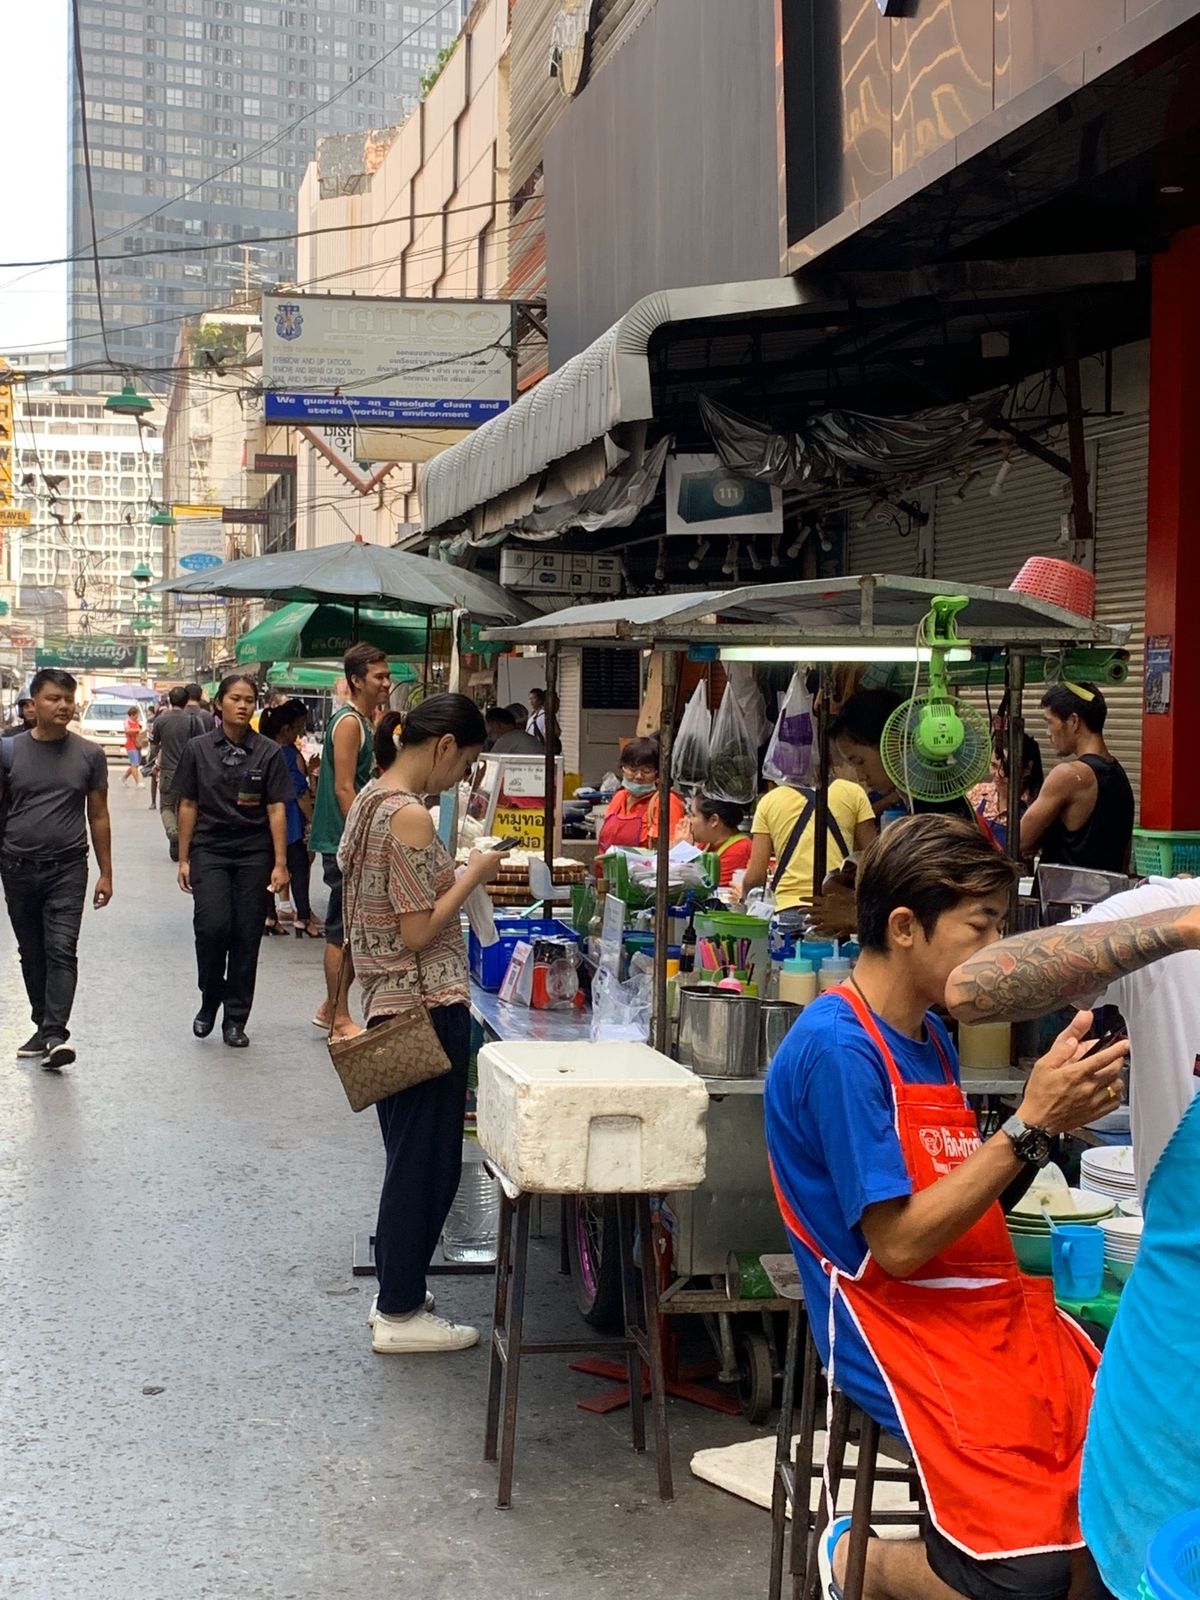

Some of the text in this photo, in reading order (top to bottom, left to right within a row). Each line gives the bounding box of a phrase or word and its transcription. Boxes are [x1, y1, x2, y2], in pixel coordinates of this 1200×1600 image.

[322, 305, 501, 335] TATTOO
[302, 357, 315, 365] AND
[295, 366, 307, 374] AND
[325, 367, 333, 375] OF
[275, 396, 296, 405] We
[303, 397, 360, 406] guarantee
[388, 400, 436, 408] absolute
[442, 401, 472, 409] clean
[479, 402, 500, 410] and
[307, 407, 470, 418] sterile working environment
[719, 487, 739, 499] 111
